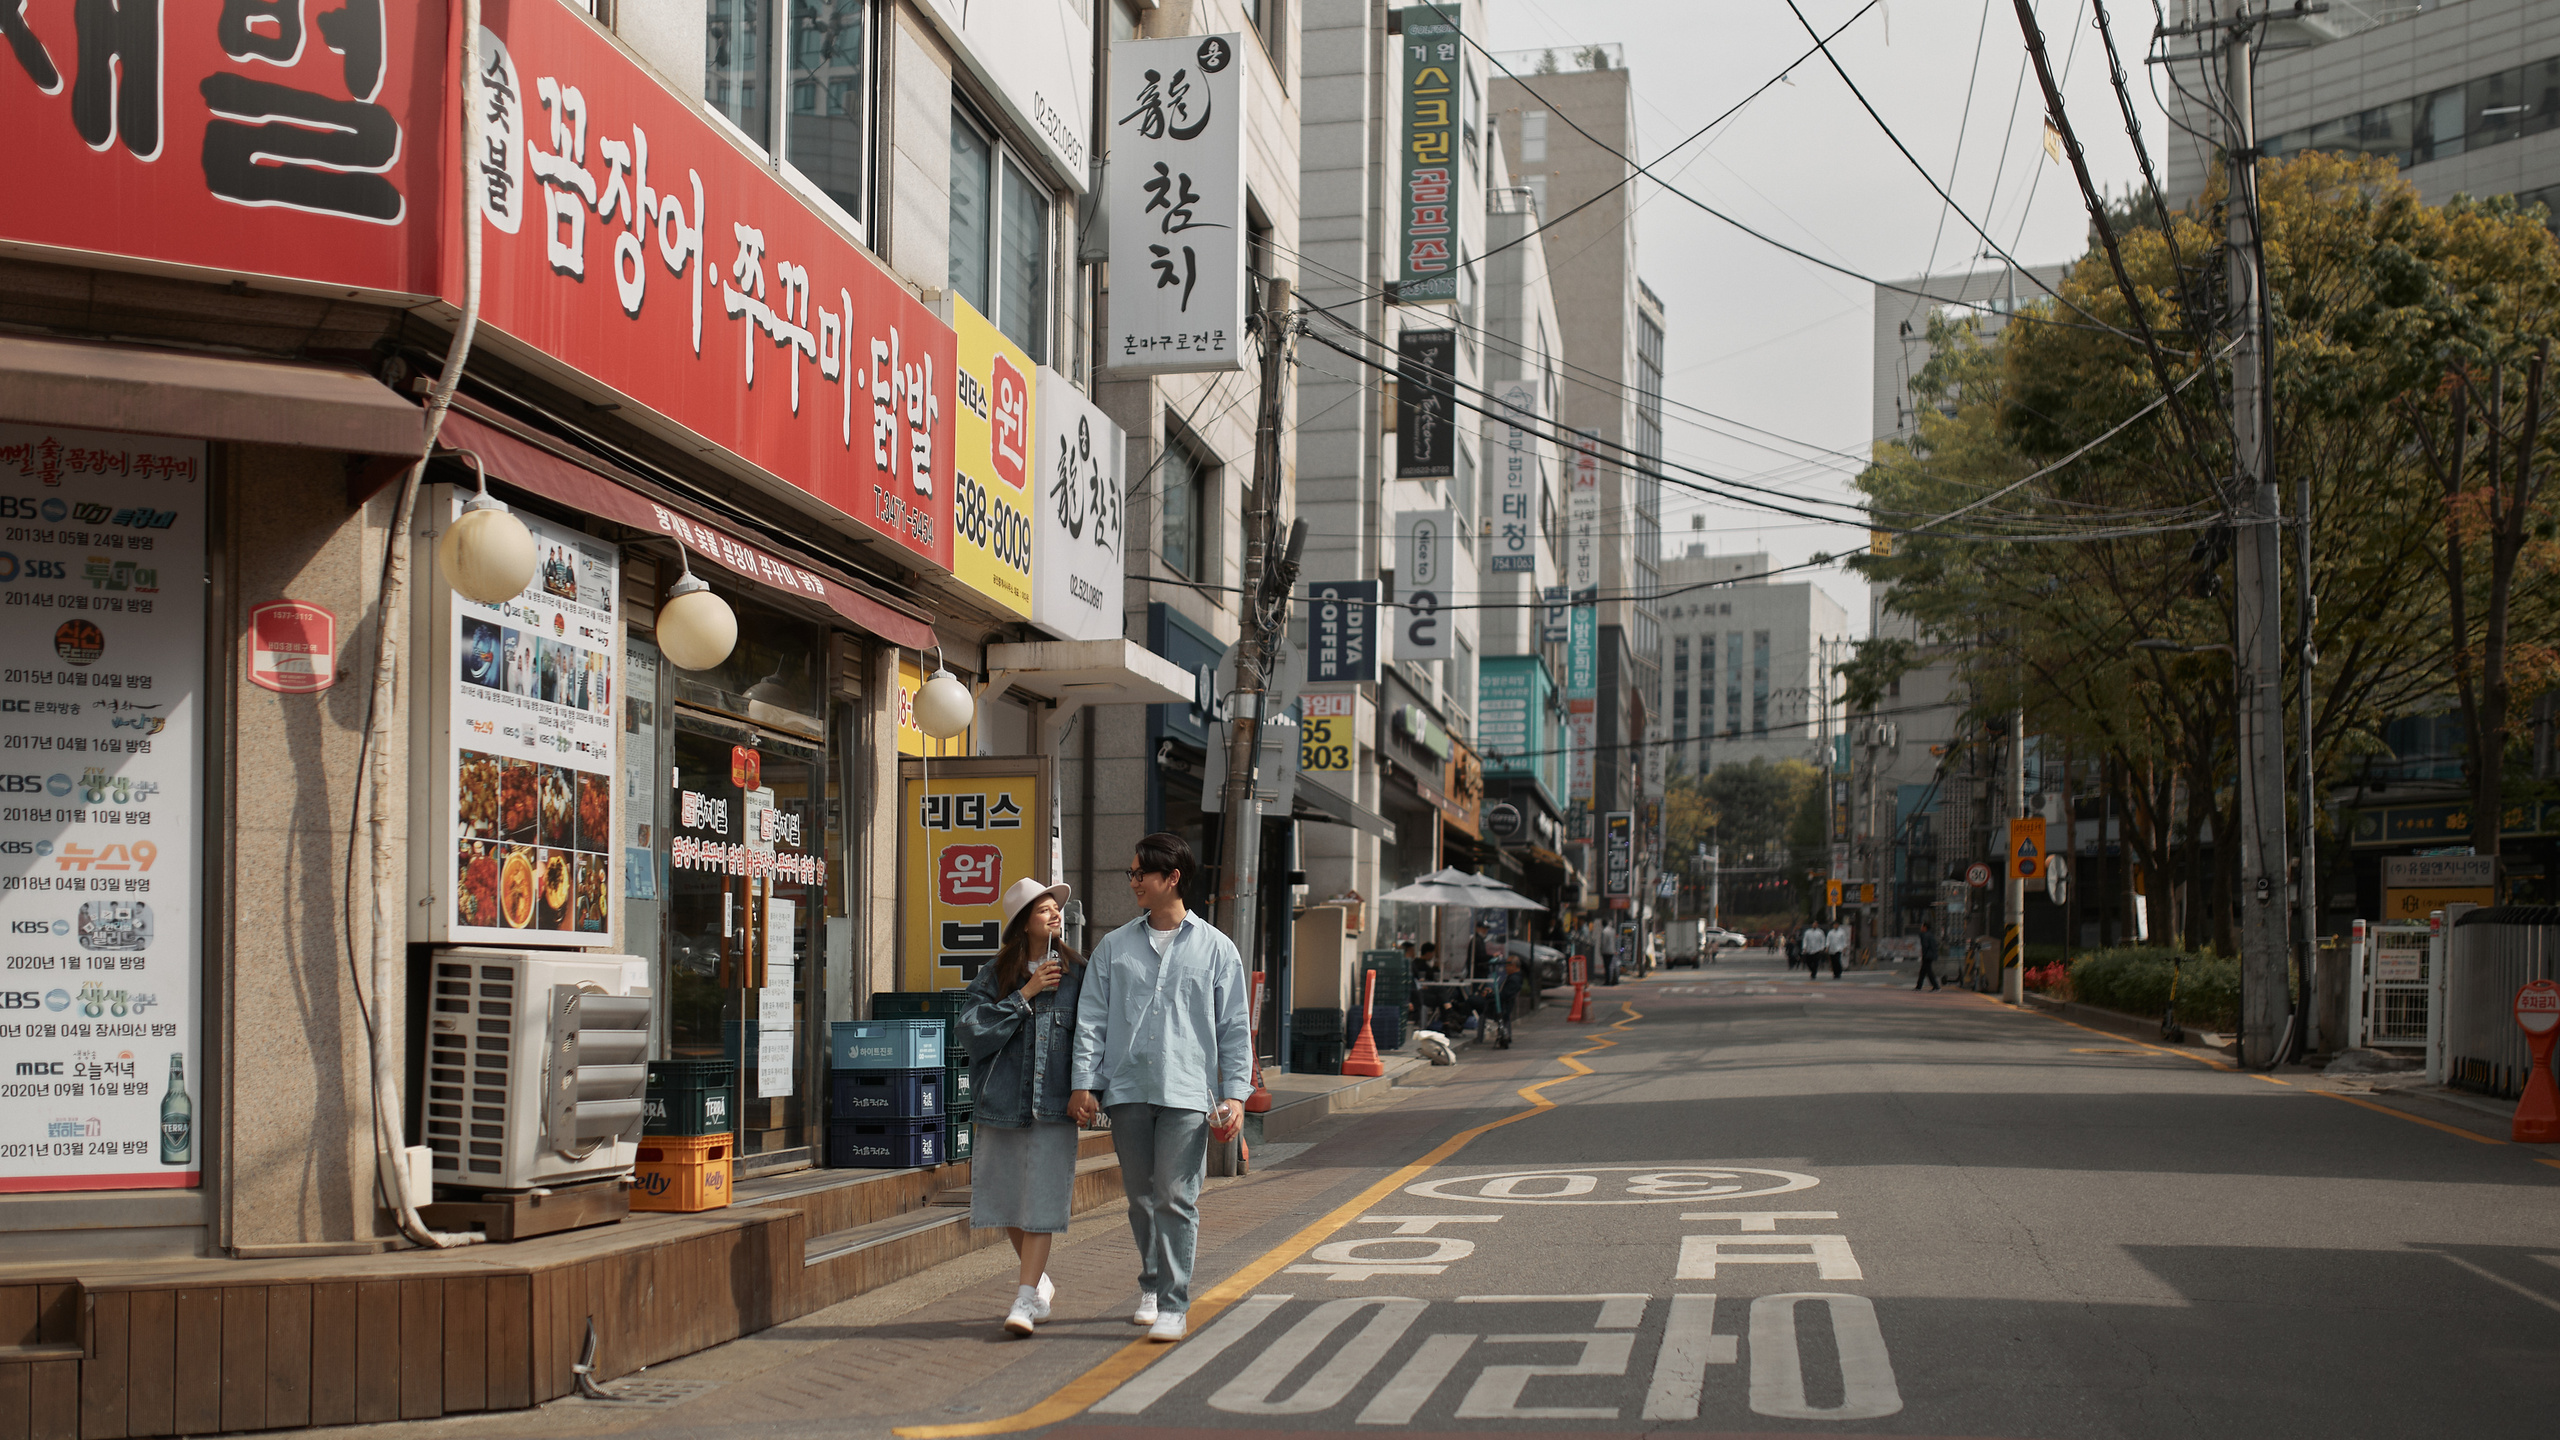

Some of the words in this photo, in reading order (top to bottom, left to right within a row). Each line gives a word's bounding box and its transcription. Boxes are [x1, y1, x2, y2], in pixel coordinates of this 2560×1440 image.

[1199, 41, 1223, 67] 용
[1411, 66, 1451, 164] 스크린
[480, 49, 516, 218] 숯불
[1034, 90, 1083, 172] 02.521.0897
[1409, 168, 1451, 273] 골프존
[1123, 329, 1228, 356] 혼마구로전문
[958, 368, 988, 423] 리더스
[996, 376, 1024, 472] 원
[37, 435, 65, 486] 숯불
[66, 448, 130, 478] 꼼장어
[132, 452, 198, 483] 쭈꾸미
[0, 495, 38, 520] BS
[72, 502, 113, 525] VJ
[112, 508, 178, 529] 특공대
[873, 485, 934, 548] T.3471-5454
[956, 468, 1032, 577] 588-8009
[1502, 493, 1527, 551] 태청
[6, 528, 54, 544] 2013년
[58, 530, 89, 547] 05월
[94, 533, 124, 549] 24일
[127, 535, 154, 551] 방영
[1418, 530, 1430, 561] Nice
[694, 525, 721, 558] 숯불
[720, 537, 759, 575] 꼼장어
[758, 554, 800, 589] 쭈꾸미
[1418, 561, 1429, 576] to
[24, 560, 66, 580] SBS
[5, 591, 54, 607] 2014년
[58, 594, 89, 610] 02월
[93, 597, 124, 612] 07일
[127, 599, 154, 614] 방영
[1408, 589, 1439, 648] CU
[1549, 606, 1564, 625] P
[1319, 587, 1339, 677] COFFEE
[1346, 596, 1364, 665] EDIYA
[4, 669, 54, 684] 2015년
[57, 672, 88, 687] 04월
[92, 674, 123, 689] 04일
[126, 675, 153, 689] 방영
[0, 700, 30, 713] BC
[34, 701, 82, 715] 문화방송
[4, 735, 53, 750] 2017년
[57, 738, 88, 752] 04월
[92, 739, 122, 753] 16일
[126, 740, 152, 754] 방영
[3, 808, 52, 822] 2018년
[56, 809, 87, 824] 01월
[92, 810, 122, 824] 10일
[125, 811, 151, 825] 방영
[919, 791, 1023, 832] 리더스
[55, 840, 158, 872] 뉴스9
[2, 876, 51, 890] 2018년
[55, 877, 86, 891] 04월
[90, 878, 121, 892] 03일
[124, 879, 151, 892] 방영
[945, 853, 995, 895] 원
[1970, 868, 1987, 881] 30
[11, 921, 50, 934] KBS
[6, 956, 55, 970] 2020년
[60, 956, 82, 970] 1월
[86, 957, 116, 970] 10일
[119, 956, 146, 970] 방영
[2521, 995, 2557, 1009] 주차금지
[25, 1024, 56, 1038] 02월
[61, 1024, 91, 1038] 04일
[95, 1023, 148, 1038] 장사의신
[151, 1023, 177, 1037] 방영
[859, 1047, 894, 1057] 하이트진로
[16, 1062, 64, 1075] MBC
[72, 1061, 135, 1081] 오늘저녁
[1, 1083, 50, 1097] 2020년
[54, 1083, 84, 1097] 09월
[90, 1083, 119, 1096] 16일
[123, 1082, 149, 1096] 방영
[643, 1099, 667, 1118] RRA
[705, 1098, 726, 1117] TERRA
[163, 1123, 189, 1133] TERRA
[1, 1143, 49, 1157] 2021년
[53, 1142, 84, 1156] 03월
[88, 1142, 118, 1155] 24일
[122, 1141, 148, 1154] 방영
[628, 1172, 671, 1195] elly
[705, 1171, 725, 1191] Kelly
[1478, 1173, 1743, 1199] 30
